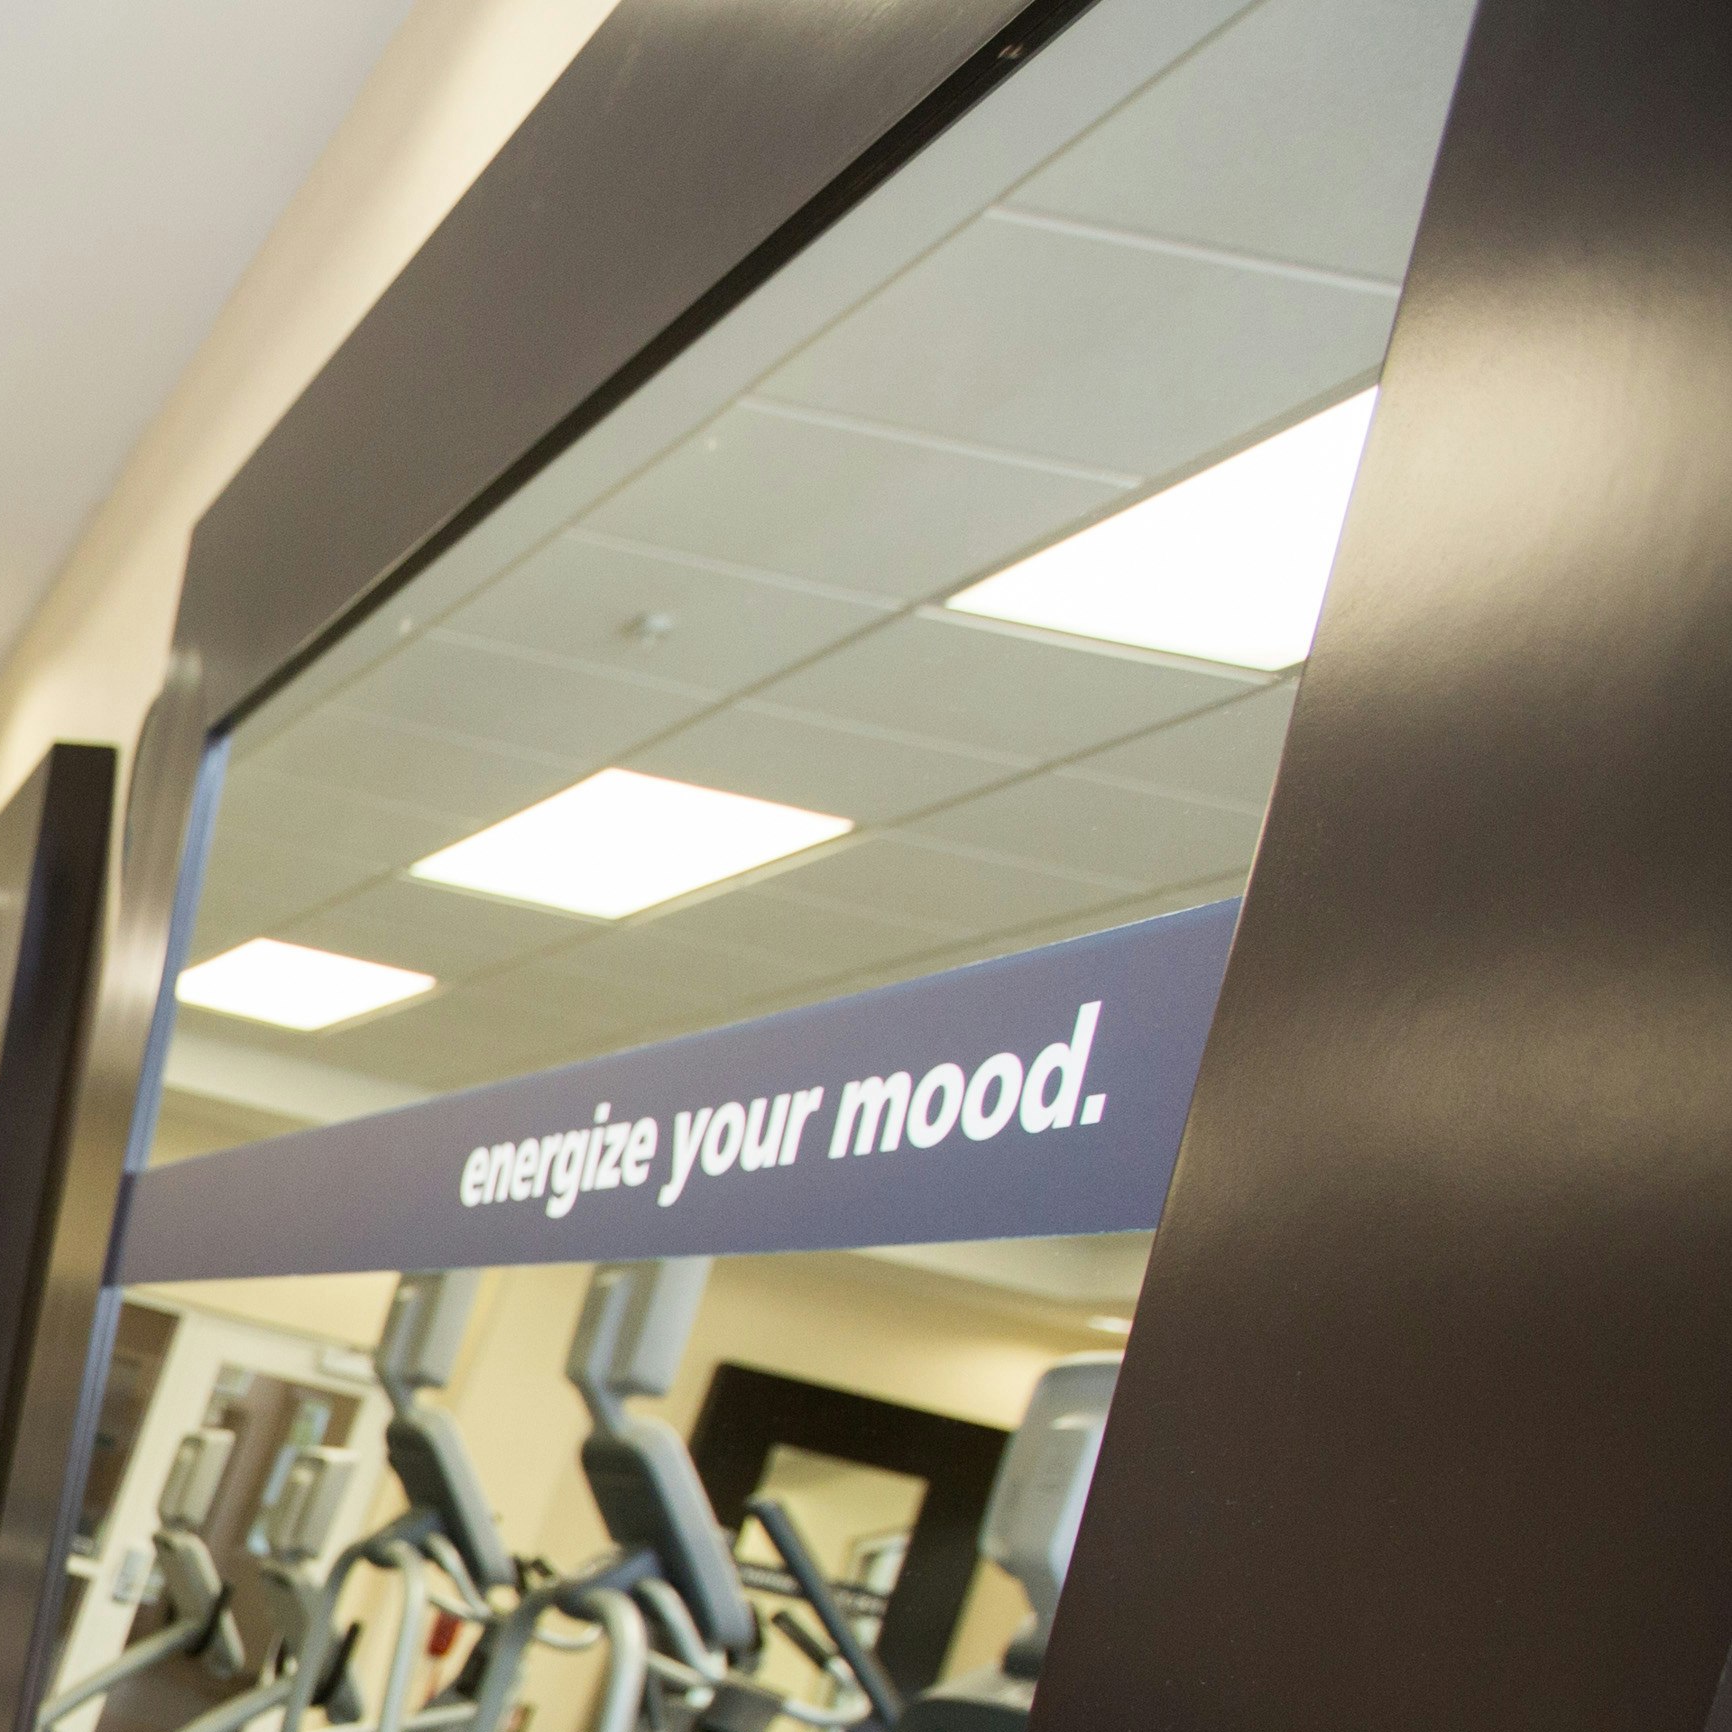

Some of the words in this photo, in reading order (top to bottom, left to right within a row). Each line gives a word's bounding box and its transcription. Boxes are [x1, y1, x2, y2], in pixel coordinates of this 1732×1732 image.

[458, 1101, 659, 1219] energize
[658, 1085, 823, 1208] your
[828, 1000, 1109, 1160] mood.
